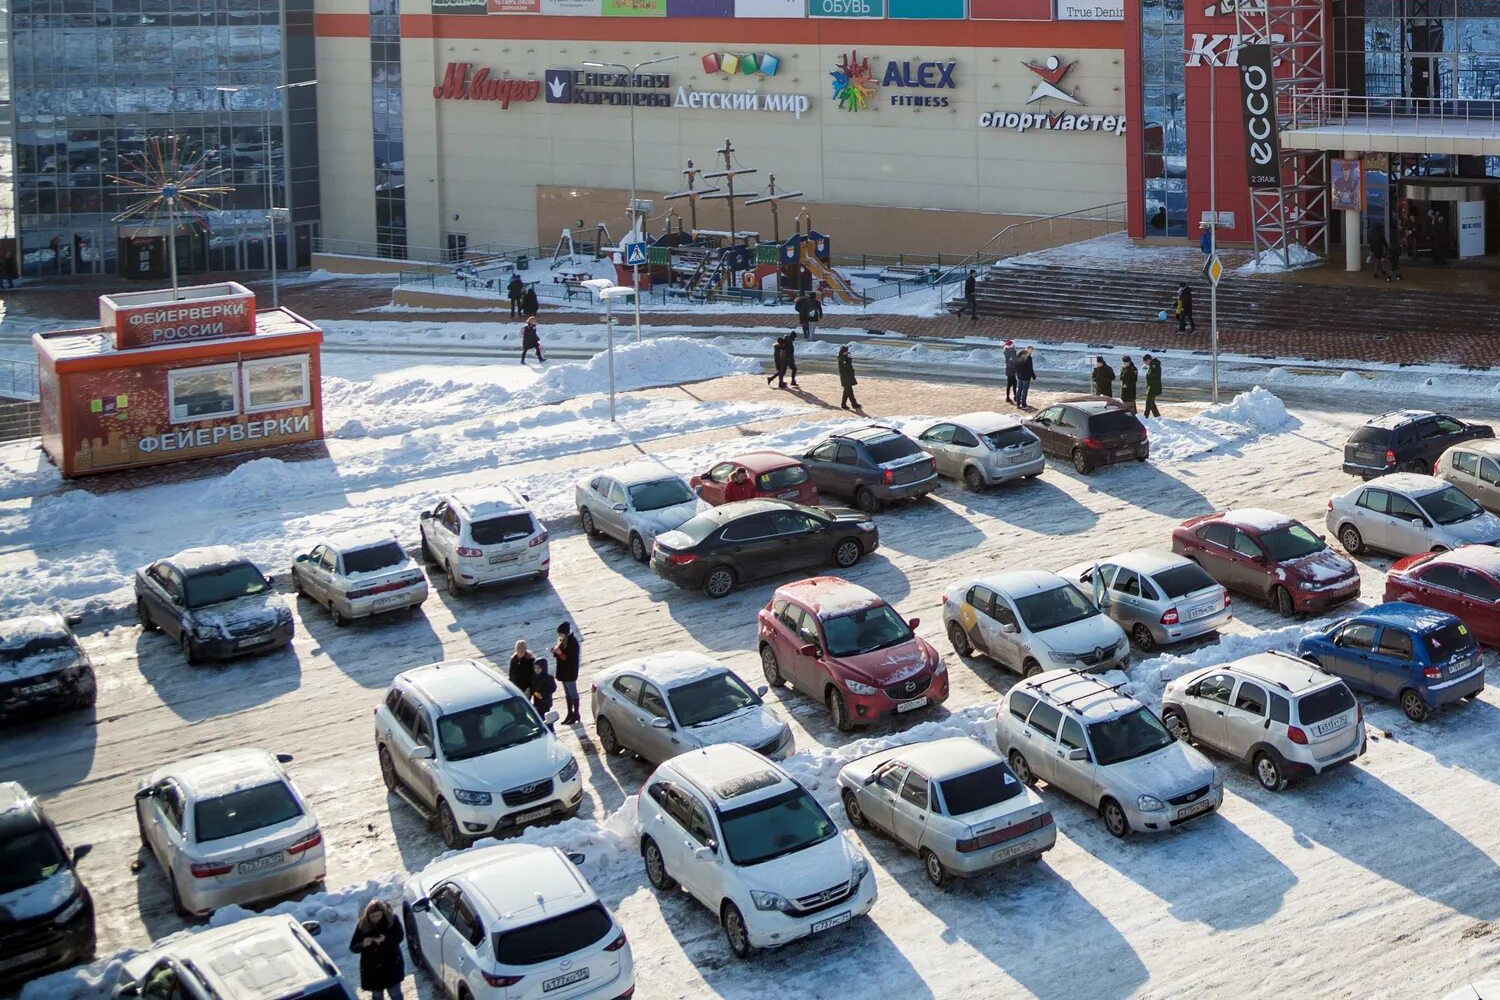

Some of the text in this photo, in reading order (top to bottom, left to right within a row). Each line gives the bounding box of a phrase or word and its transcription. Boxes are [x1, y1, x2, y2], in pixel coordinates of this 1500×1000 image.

[822, 0, 870, 13] ОБУВЬ
[1066, 6, 1093, 18] True
[573, 70, 670, 88] Снежная
[882, 60, 957, 89] ALEX
[574, 89, 671, 107] Королева
[674, 86, 811, 119] Детский мир
[891, 95, 949, 107] FITNESS
[1244, 65, 1273, 165] ecco
[129, 302, 244, 326] ФЕЙЕРВЕРКИ
[152, 322, 224, 341] РОССИИ
[138, 415, 311, 453] ФЕЙЕРВЕРКИ
